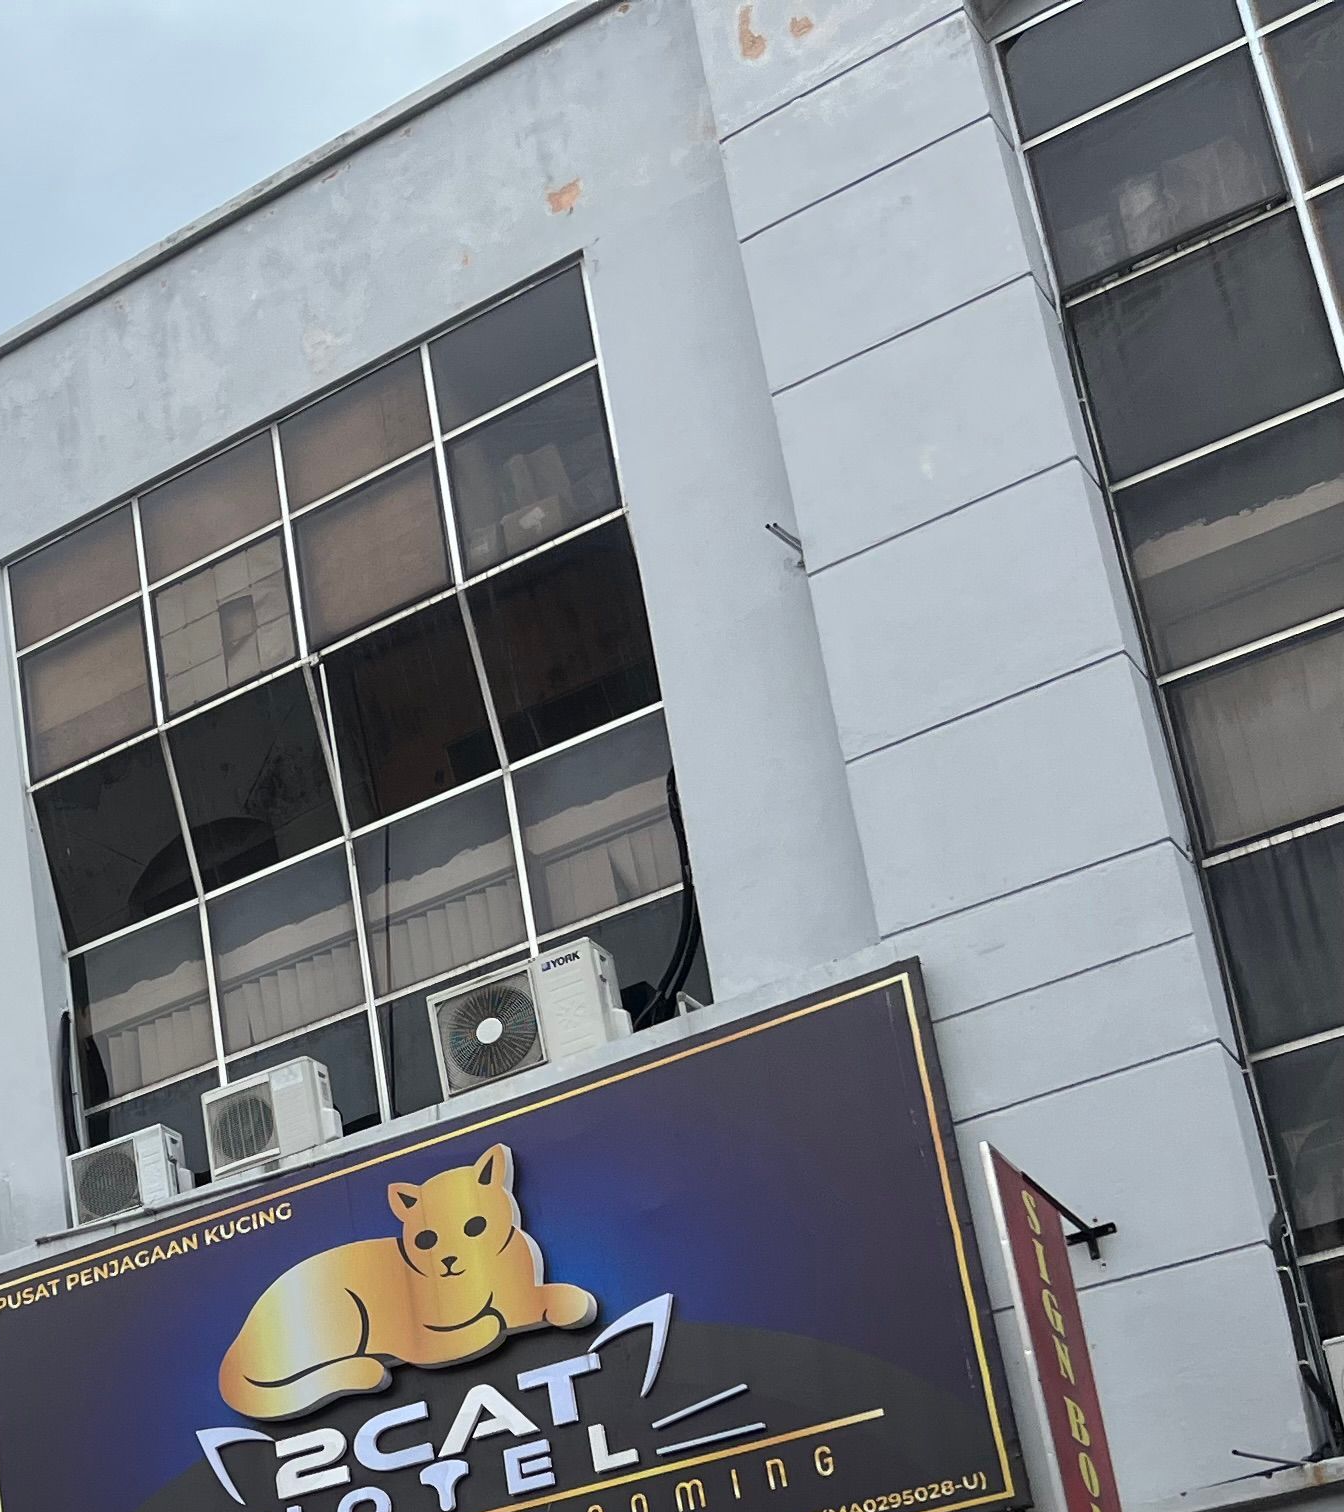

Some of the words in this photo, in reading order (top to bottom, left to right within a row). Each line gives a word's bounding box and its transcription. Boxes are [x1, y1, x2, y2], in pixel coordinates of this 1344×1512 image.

[550, 950, 581, 969] YORK
[67, 1233, 199, 1291] PENJAGAAN
[204, 1203, 293, 1245] KUCING
[275, 1352, 600, 1499] 2CAT
